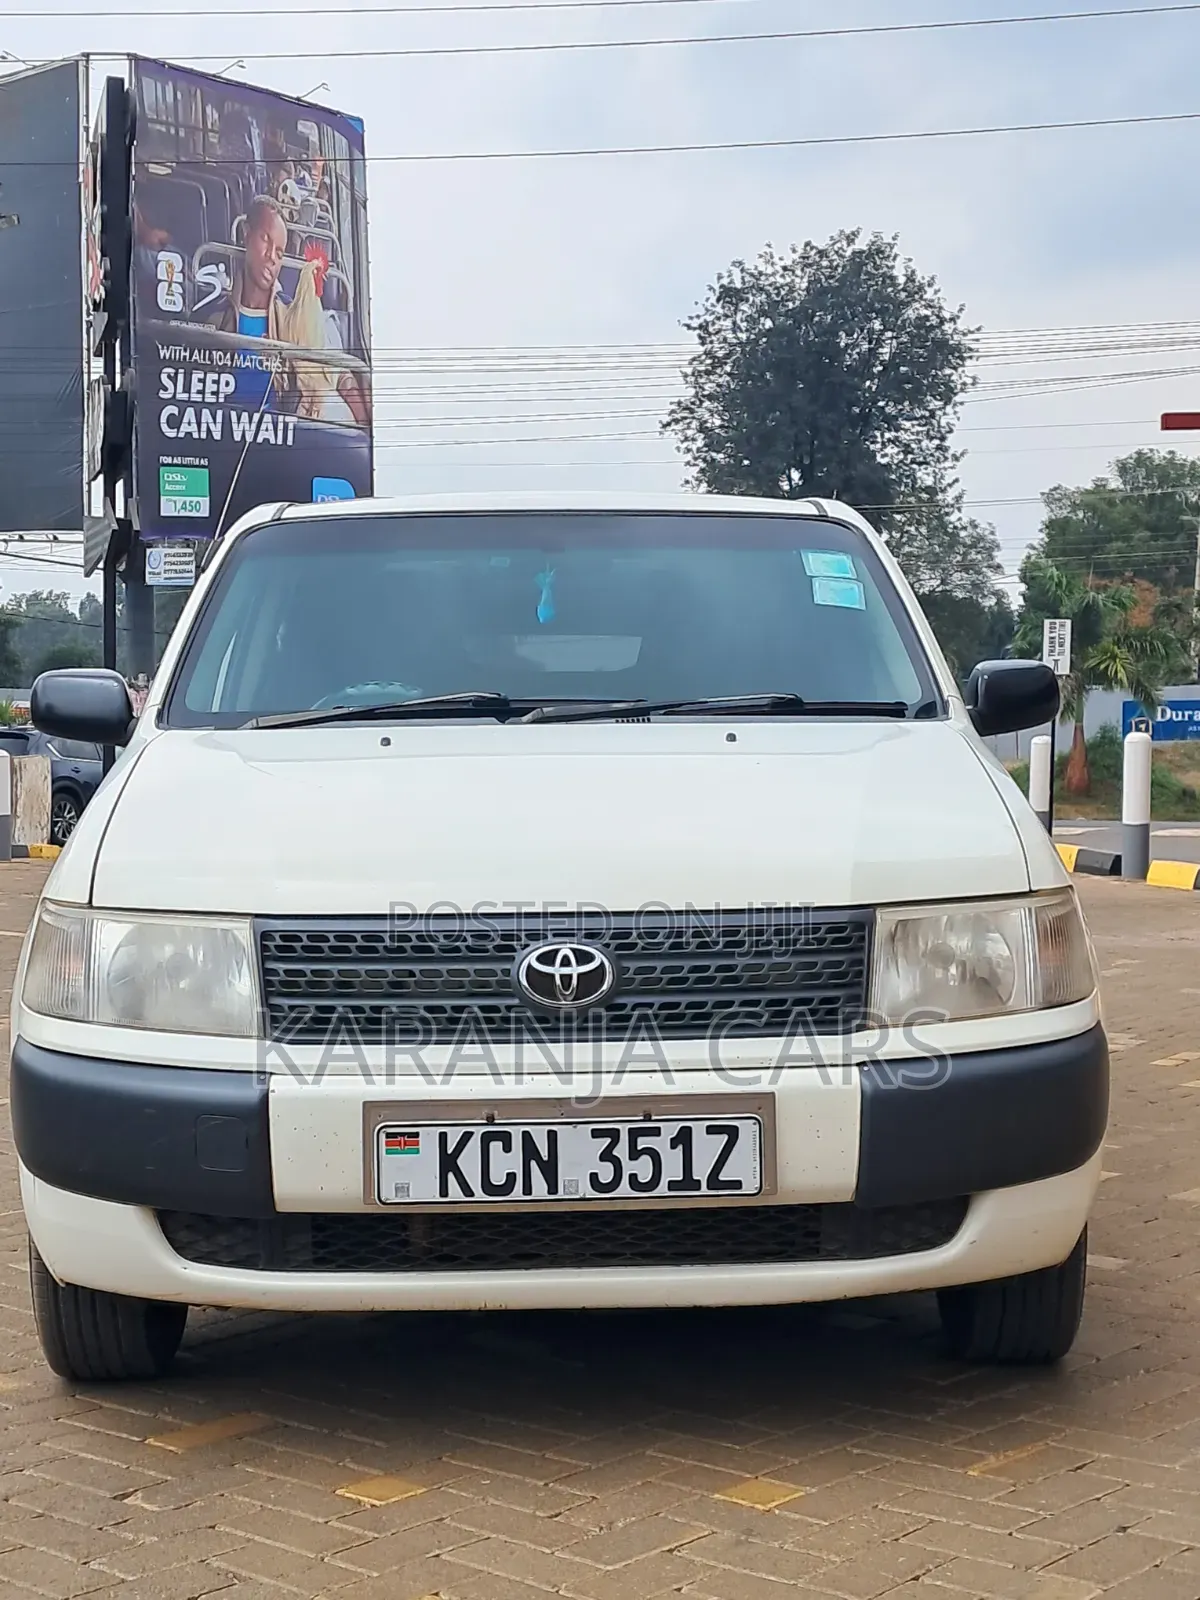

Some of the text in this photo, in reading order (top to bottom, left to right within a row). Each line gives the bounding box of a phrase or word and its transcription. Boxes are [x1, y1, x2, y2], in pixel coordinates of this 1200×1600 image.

[158, 344, 190, 362] WITH
[191, 348, 211, 364] ALL
[212, 350, 232, 367] 104
[158, 366, 236, 403] SLEEP
[159, 404, 299, 446] CAN WAIT
[160, 456, 209, 466] FOR AS LITTLE AS
[172, 500, 202, 515] 1,450
[1048, 621, 1057, 657] THANK YOU
[1057, 633, 1066, 648] NEXT
[437, 1129, 559, 1198] KCN
[588, 1125, 743, 1193] 351Z
